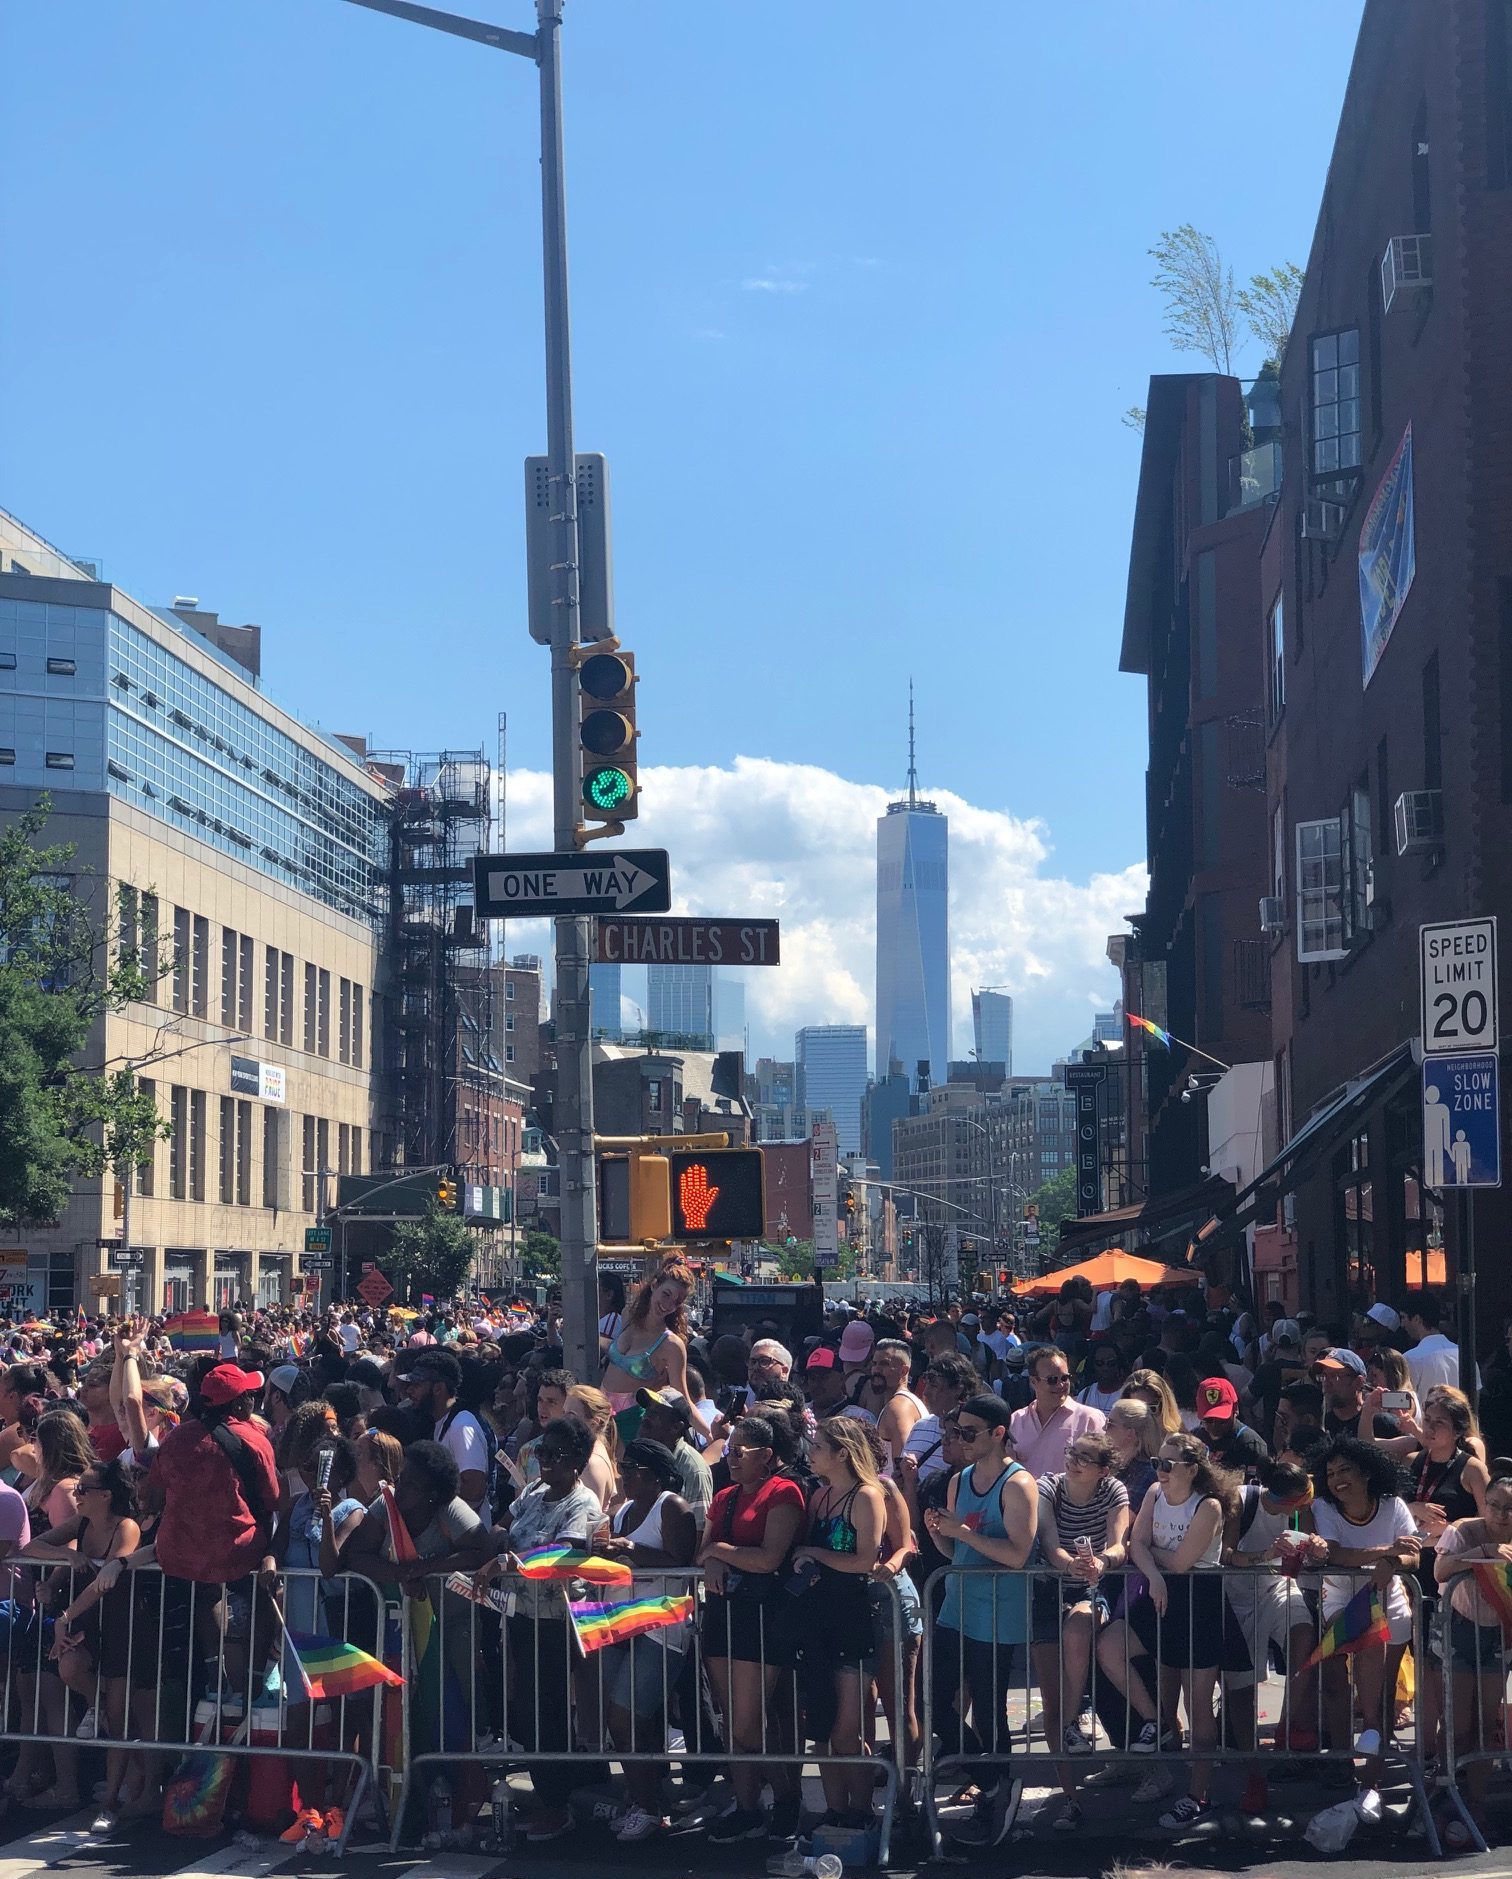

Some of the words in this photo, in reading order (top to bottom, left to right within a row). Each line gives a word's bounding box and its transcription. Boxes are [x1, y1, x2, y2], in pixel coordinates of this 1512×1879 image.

[503, 873, 558, 898] ONE
[583, 870, 640, 896] WAY
[605, 924, 723, 961] CHARLES
[740, 926, 769, 962] ST
[1429, 933, 1488, 959] SPEED
[1434, 960, 1484, 985] LIMIT
[1433, 990, 1488, 1038] 20
[1069, 1071, 1101, 1079] RESTAURANT
[1446, 1061, 1493, 1071] NEIGHBORHOOD
[1454, 1072, 1491, 1091] SLOW
[1453, 1093, 1492, 1112] ZONE
[1080, 1095, 1096, 1199] BOBO
